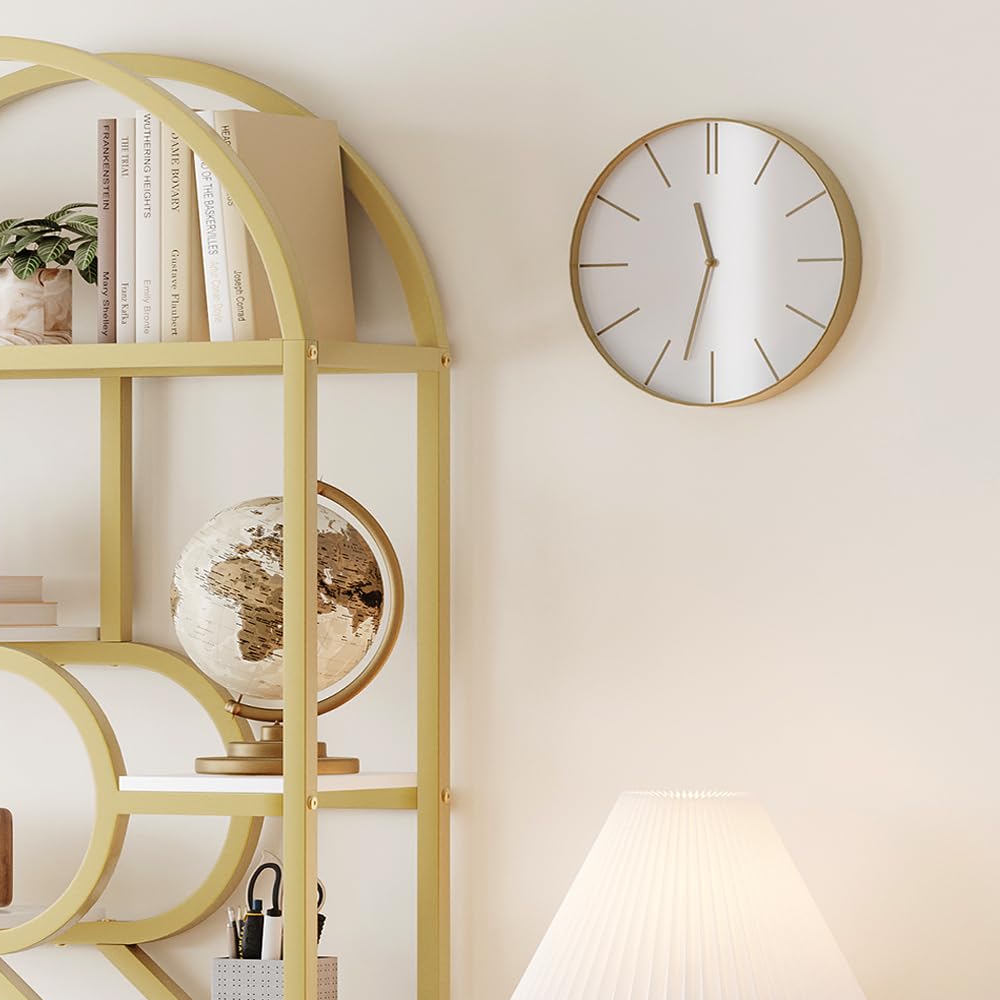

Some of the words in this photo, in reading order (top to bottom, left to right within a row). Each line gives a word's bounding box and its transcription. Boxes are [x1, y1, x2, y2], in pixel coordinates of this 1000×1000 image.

[121, 137, 129, 153] THE
[143, 113, 151, 173] WUTHERING
[102, 125, 110, 210] FRANKENSTEIN
[202, 170, 212, 183] OF
[143, 175, 151, 219] HEIGHTS
[171, 168, 180, 212] BOVARY
[203, 183, 214, 199] THE
[204, 200, 218, 255] BASKERVILLES
[101, 271, 110, 296] Mary
[171, 249, 179, 290] Gustave
[233, 270, 244, 296] Joseph
[141, 279, 151, 303] Emily
[101, 299, 110, 336] Shelley
[121, 303, 129, 325] Kafka
[171, 293, 180, 335] Flaubert
[236, 296, 246, 321] Conrad
